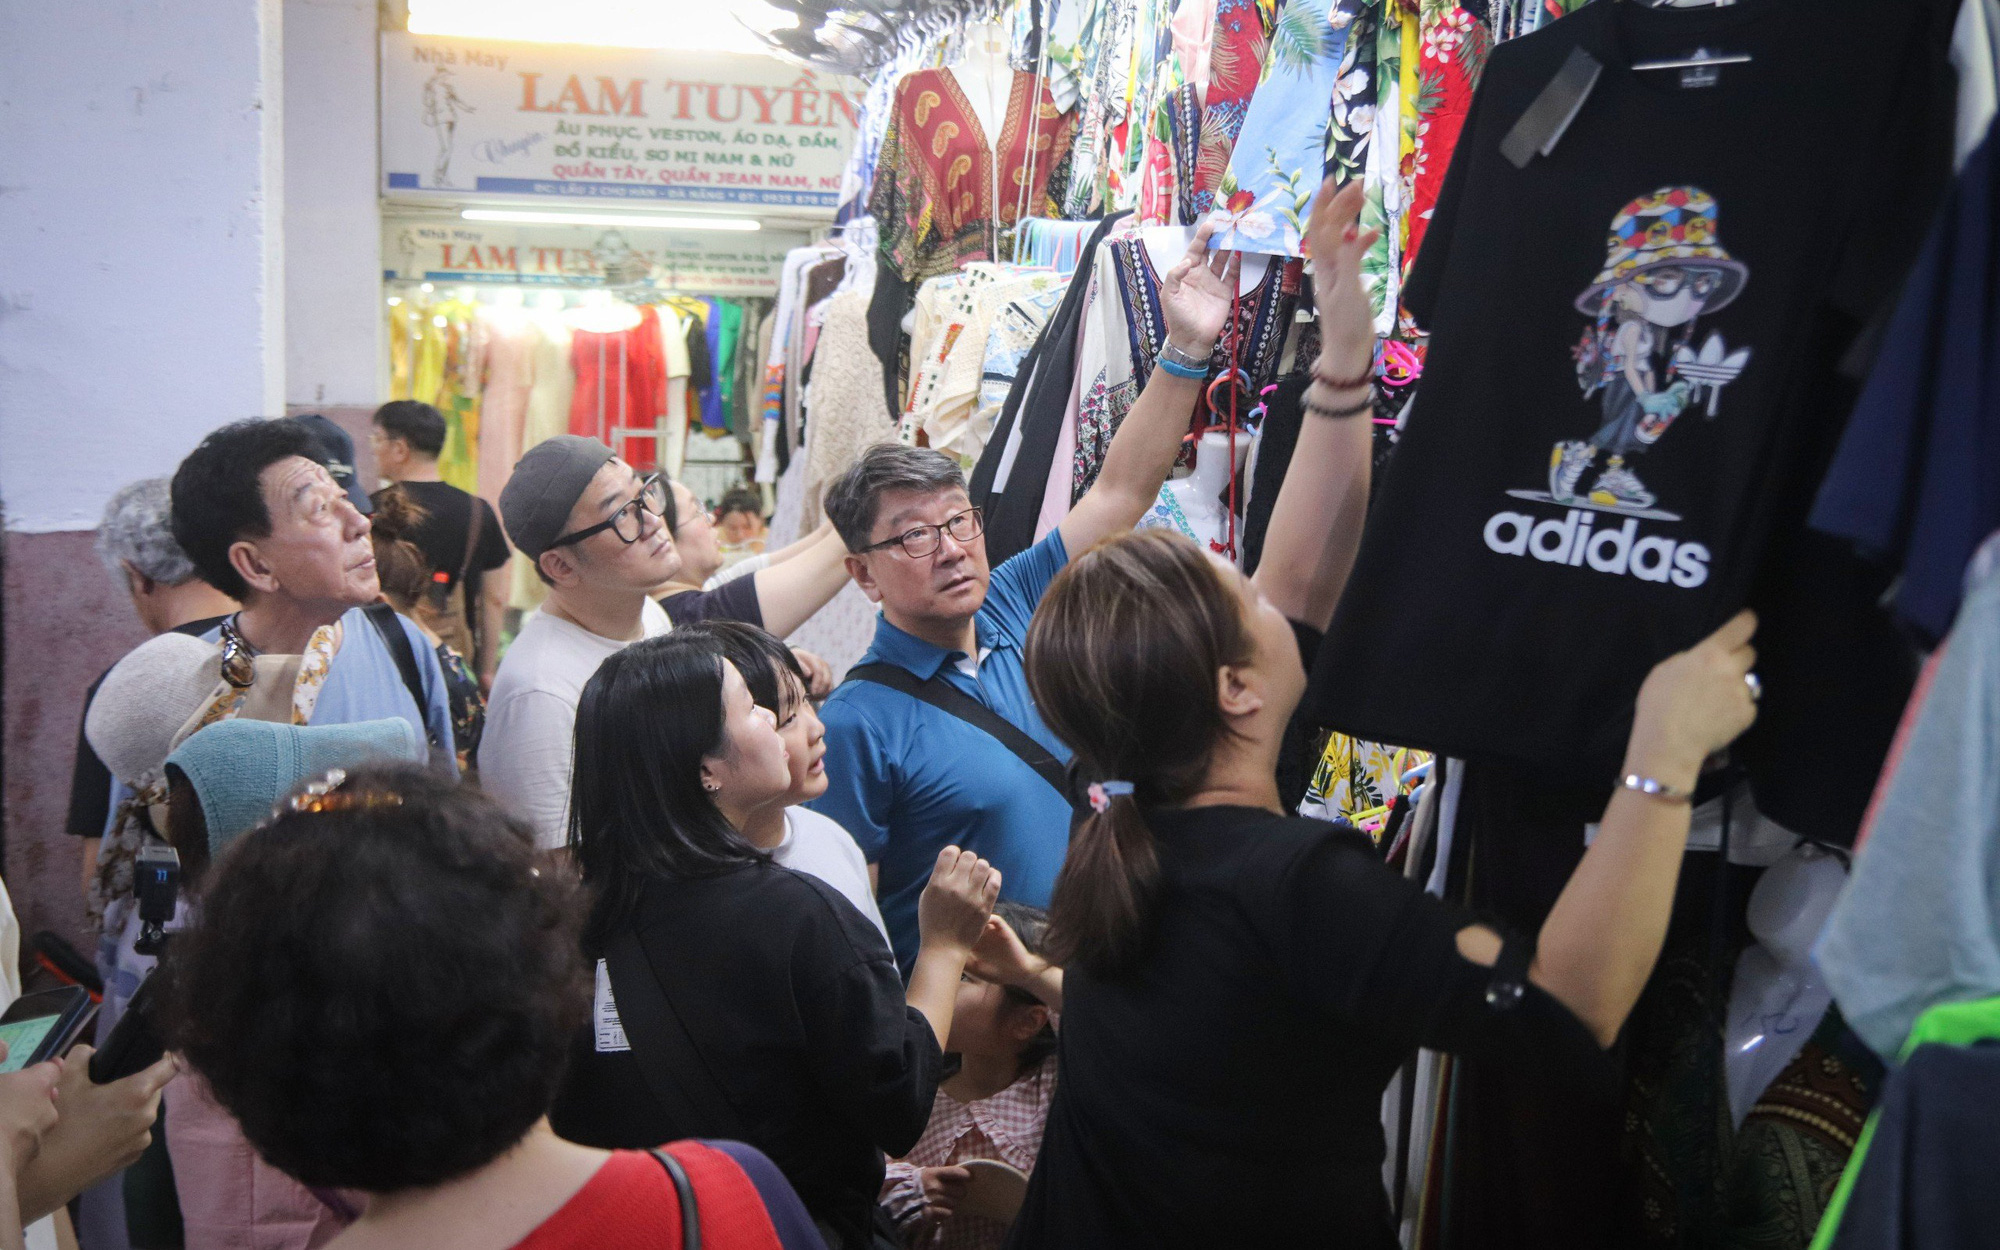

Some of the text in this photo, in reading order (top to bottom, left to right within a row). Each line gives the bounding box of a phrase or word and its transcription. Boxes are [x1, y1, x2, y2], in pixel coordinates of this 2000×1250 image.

[517, 69, 867, 129] LAM TUYỀN
[555, 119, 581, 136] ÂU
[587, 124, 643, 141] PHỤC,
[649, 128, 726, 145] VESTON,
[732, 128, 757, 145] ÁO
[675, 150, 698, 164] MI
[704, 152, 743, 166] NAM
[750, 154, 763, 166] &
[769, 153, 796, 168] NỮ
[611, 164, 653, 183] TÂY,
[715, 171, 762, 185] JEAN
[768, 173, 813, 190] NAM,
[440, 243, 518, 271] LAM
[529, 246, 655, 274] TUYN
[1483, 509, 1711, 588] adidas
